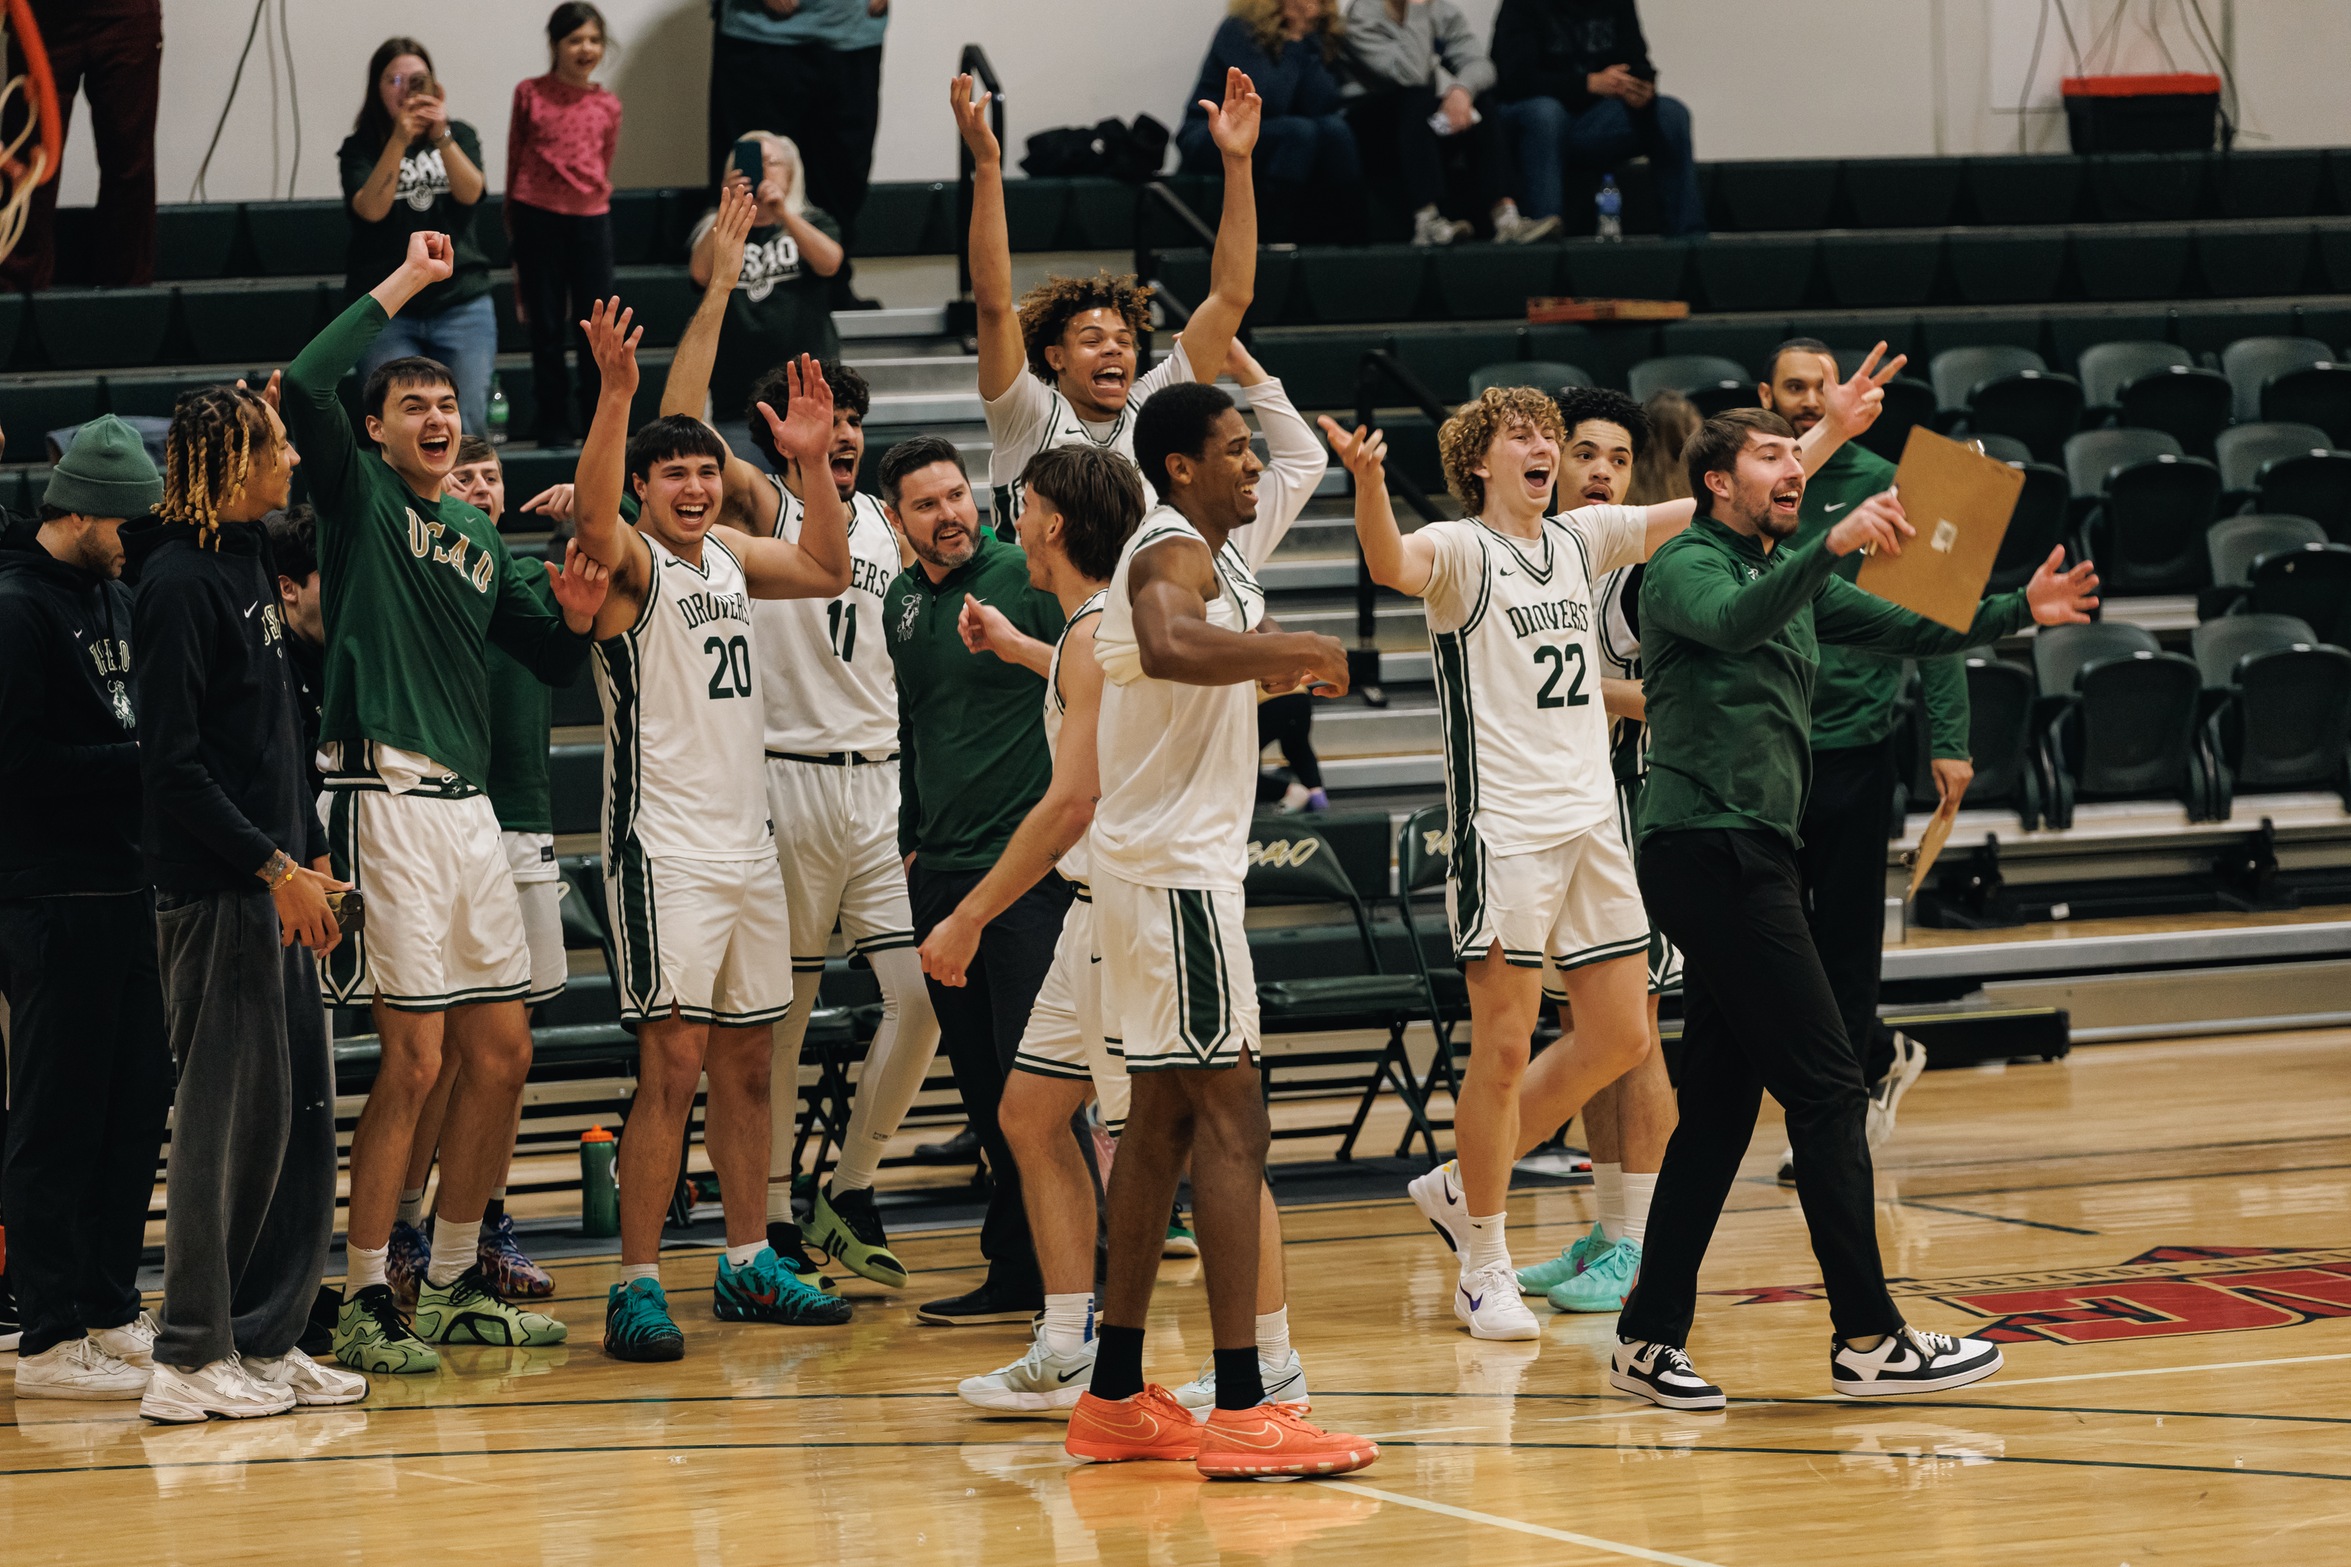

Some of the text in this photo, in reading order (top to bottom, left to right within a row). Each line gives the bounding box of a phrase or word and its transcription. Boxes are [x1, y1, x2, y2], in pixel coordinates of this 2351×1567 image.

[742, 235, 799, 280] SAO
[405, 506, 494, 594] USAO
[849, 555, 890, 599] ERS
[826, 599, 857, 663] 11
[703, 634, 752, 700] 20
[1533, 642, 1590, 709] 22
[1247, 837, 1320, 869] SAO
[1887, 1265, 2180, 1293] CONFEREN
